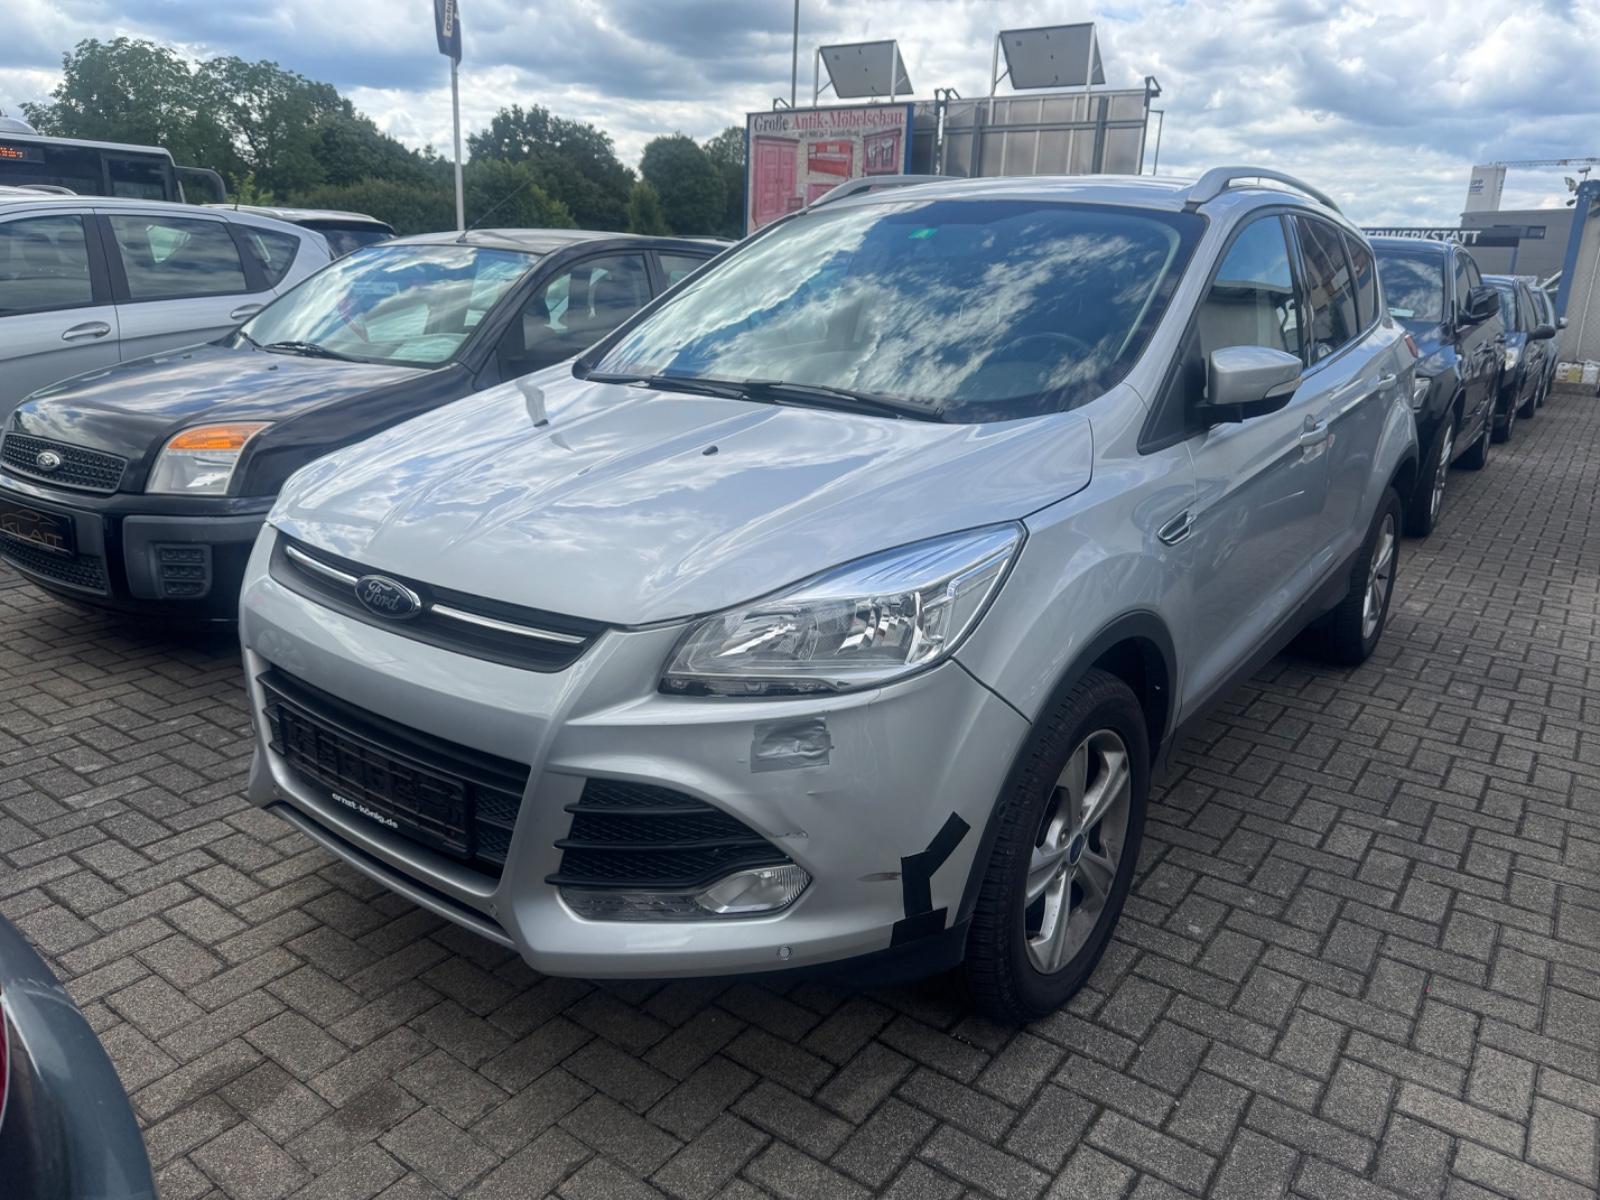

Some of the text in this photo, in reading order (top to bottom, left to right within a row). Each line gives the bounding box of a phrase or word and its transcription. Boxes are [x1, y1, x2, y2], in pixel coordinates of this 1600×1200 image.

[754, 109, 904, 132] Große Antik-Möbelschau
[364, 580, 401, 611] Ford
[331, 792, 399, 829] ernst-könig.de
